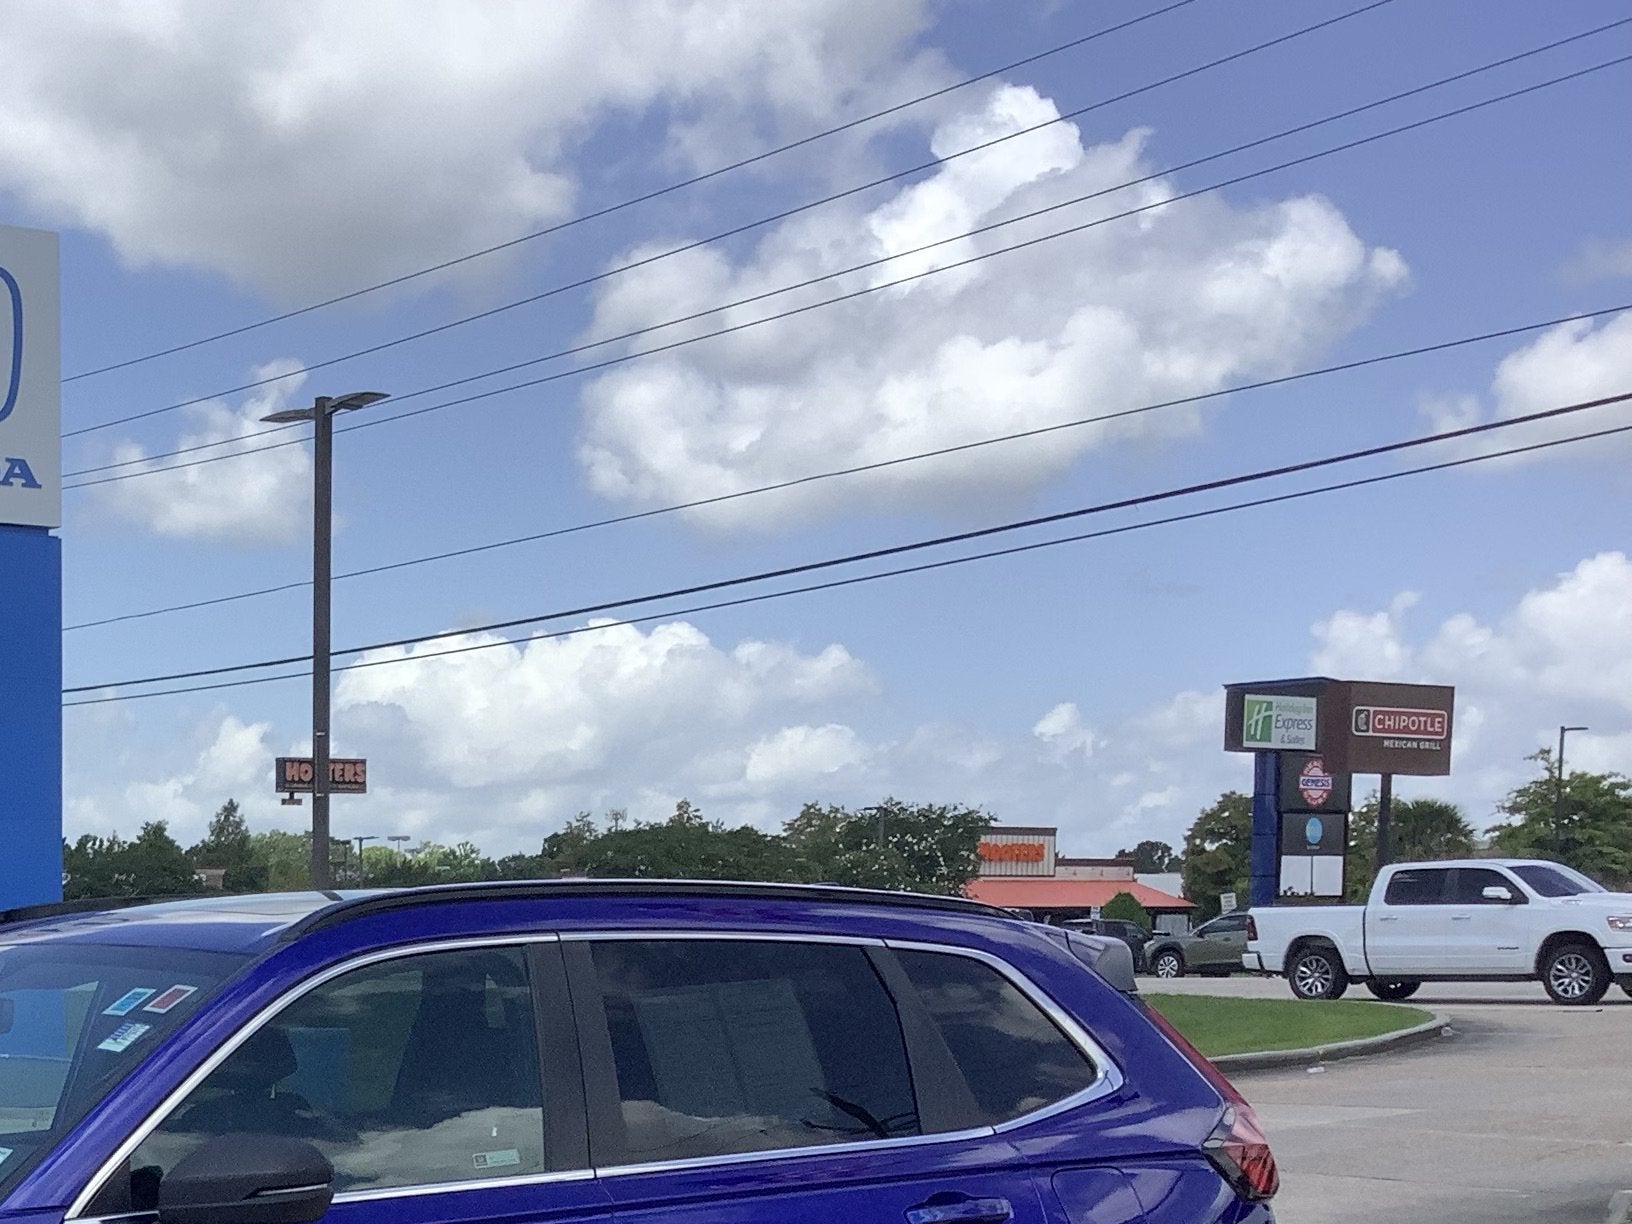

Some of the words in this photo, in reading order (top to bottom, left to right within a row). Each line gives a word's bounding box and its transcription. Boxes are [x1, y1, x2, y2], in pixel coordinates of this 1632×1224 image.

[1274, 713, 1313, 733] Express
[1374, 714, 1443, 732] CHIPOTLE
[1383, 739, 1418, 749] MEXICAN
[1419, 741, 1441, 750] GRILL
[285, 761, 365, 783] HOTERS
